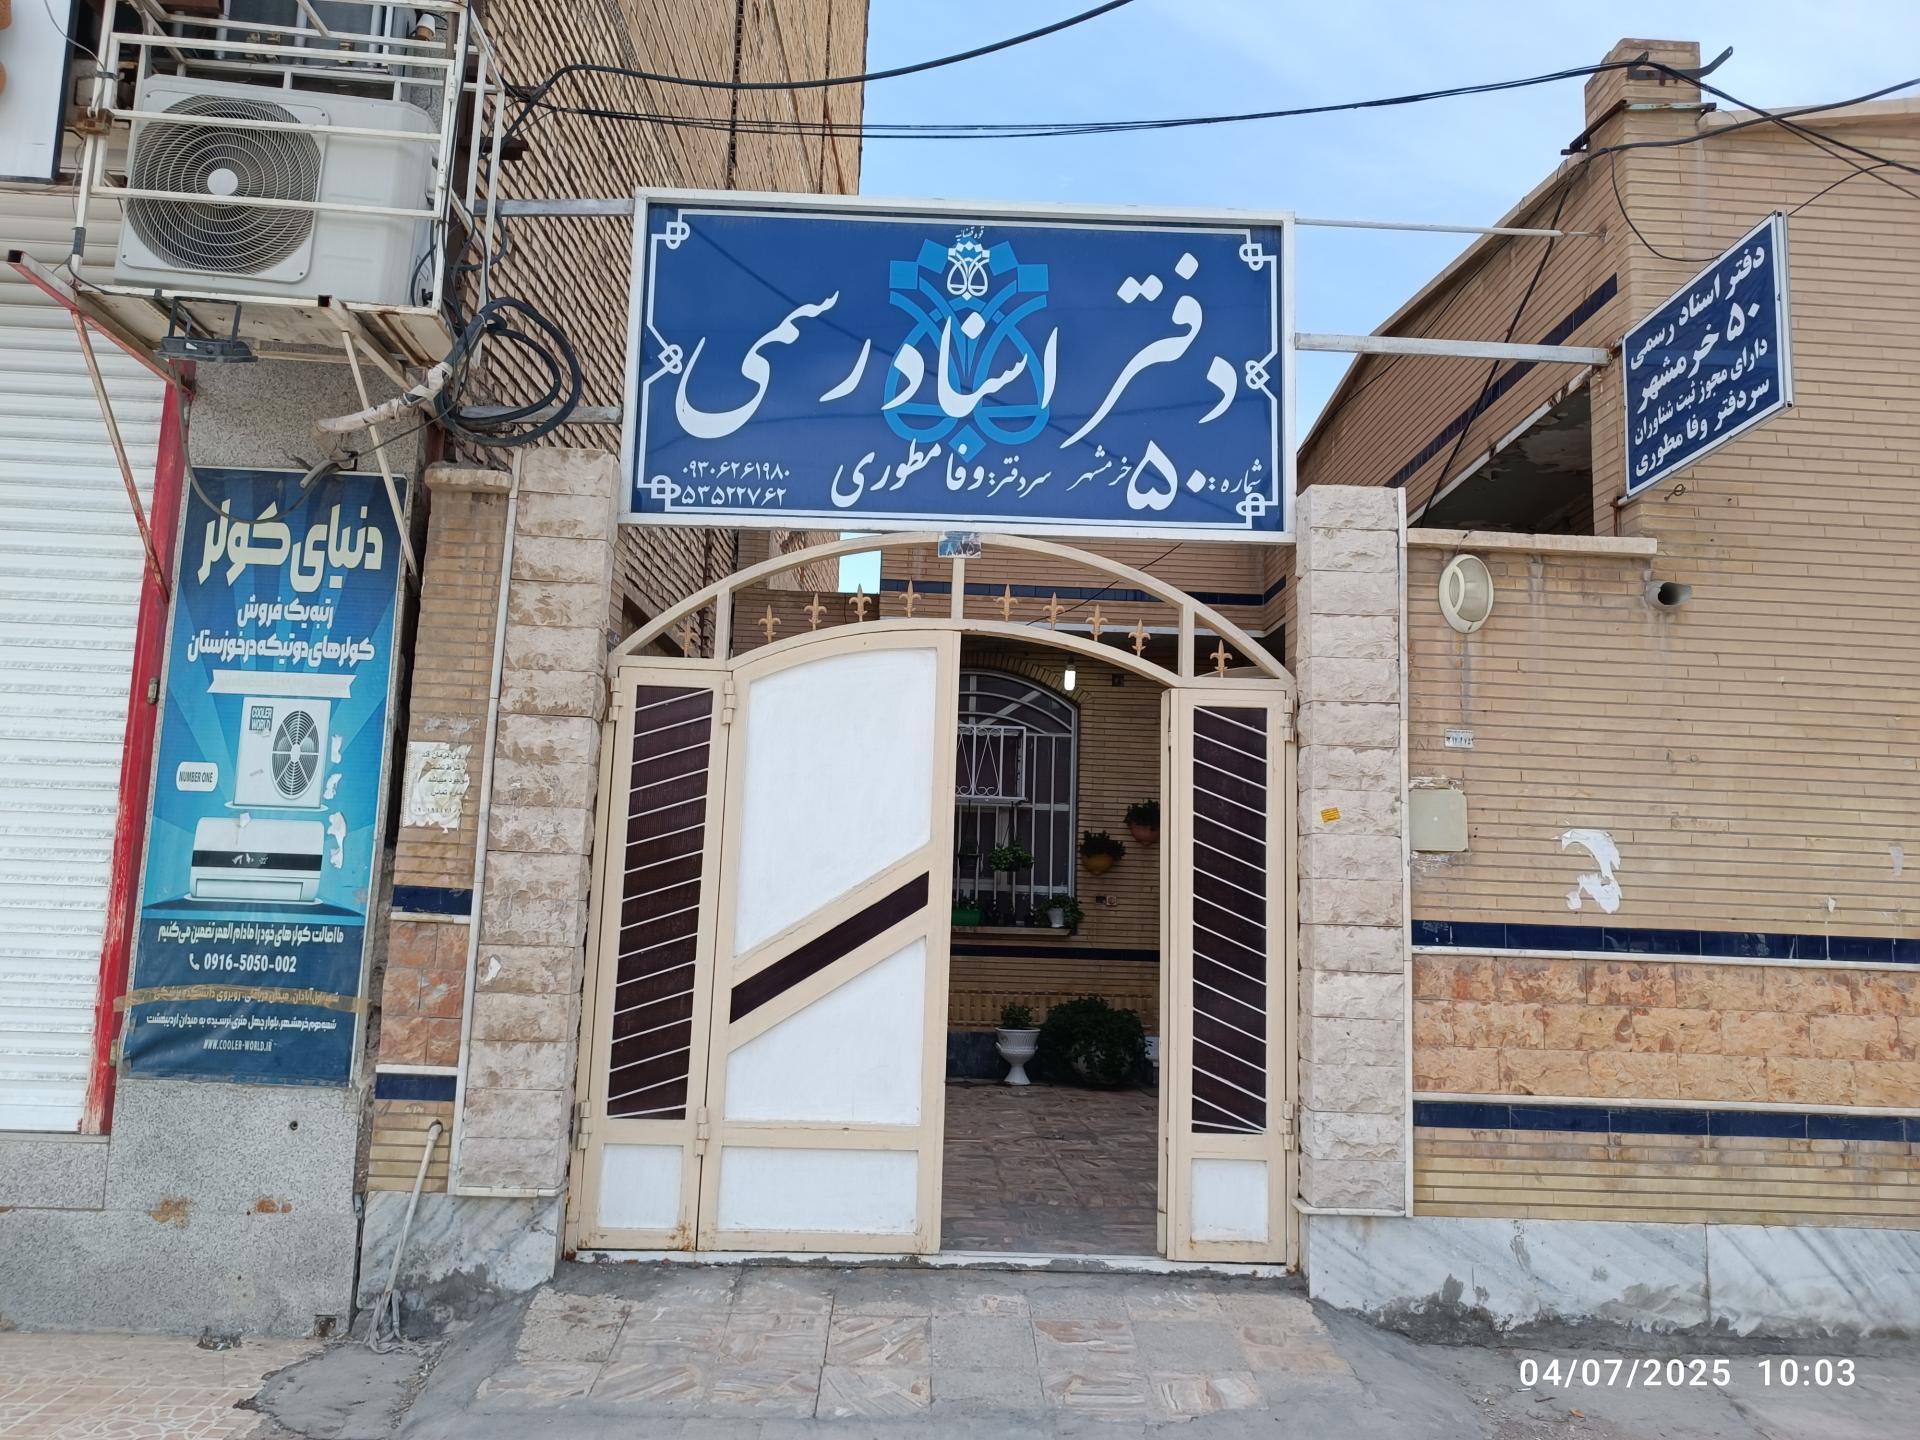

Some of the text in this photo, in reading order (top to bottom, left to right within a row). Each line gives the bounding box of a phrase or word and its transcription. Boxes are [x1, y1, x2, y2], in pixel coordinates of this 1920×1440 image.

[1631, 246, 1765, 370] دفتر اسناد رسمی
[675, 252, 1238, 449] دفتر اسناد رسمی
[1636, 302, 1761, 414] ۵۰ خرمشهر
[1634, 337, 1768, 445] دارای مجوز ثبت شناوران
[1686, 414, 1707, 440] وفا
[945, 444, 985, 492] وفا
[1636, 433, 1683, 477] مطوری
[682, 460, 790, 482] ۰۹۳۰۶۲۶۱۹۸۰
[831, 438, 941, 508] مطوری
[1066, 445, 1132, 492] خرمشهر
[1127, 440, 1207, 511] ۵۰
[681, 485, 788, 506] ۵۳۵۲۲۷۶۲
[198, 498, 383, 592] دنیای کولر
[237, 594, 334, 629] رتبه یک فروش
[308, 635, 375, 667] کولرهای
[251, 707, 272, 719] COOLER
[251, 719, 271, 731] WORLD
[179, 771, 213, 783] NUMBER ONE
[190, 922, 215, 944] تضمین
[336, 926, 344, 943] ما
[204, 953, 297, 973] 0916-5050-002
[146, 1012, 179, 1027] اردیبهشت
[178, 1013, 198, 1028] میدان
[199, 1016, 206, 1028] به
[203, 1039, 272, 1052] WWW.COOLER-WORLD.IR
